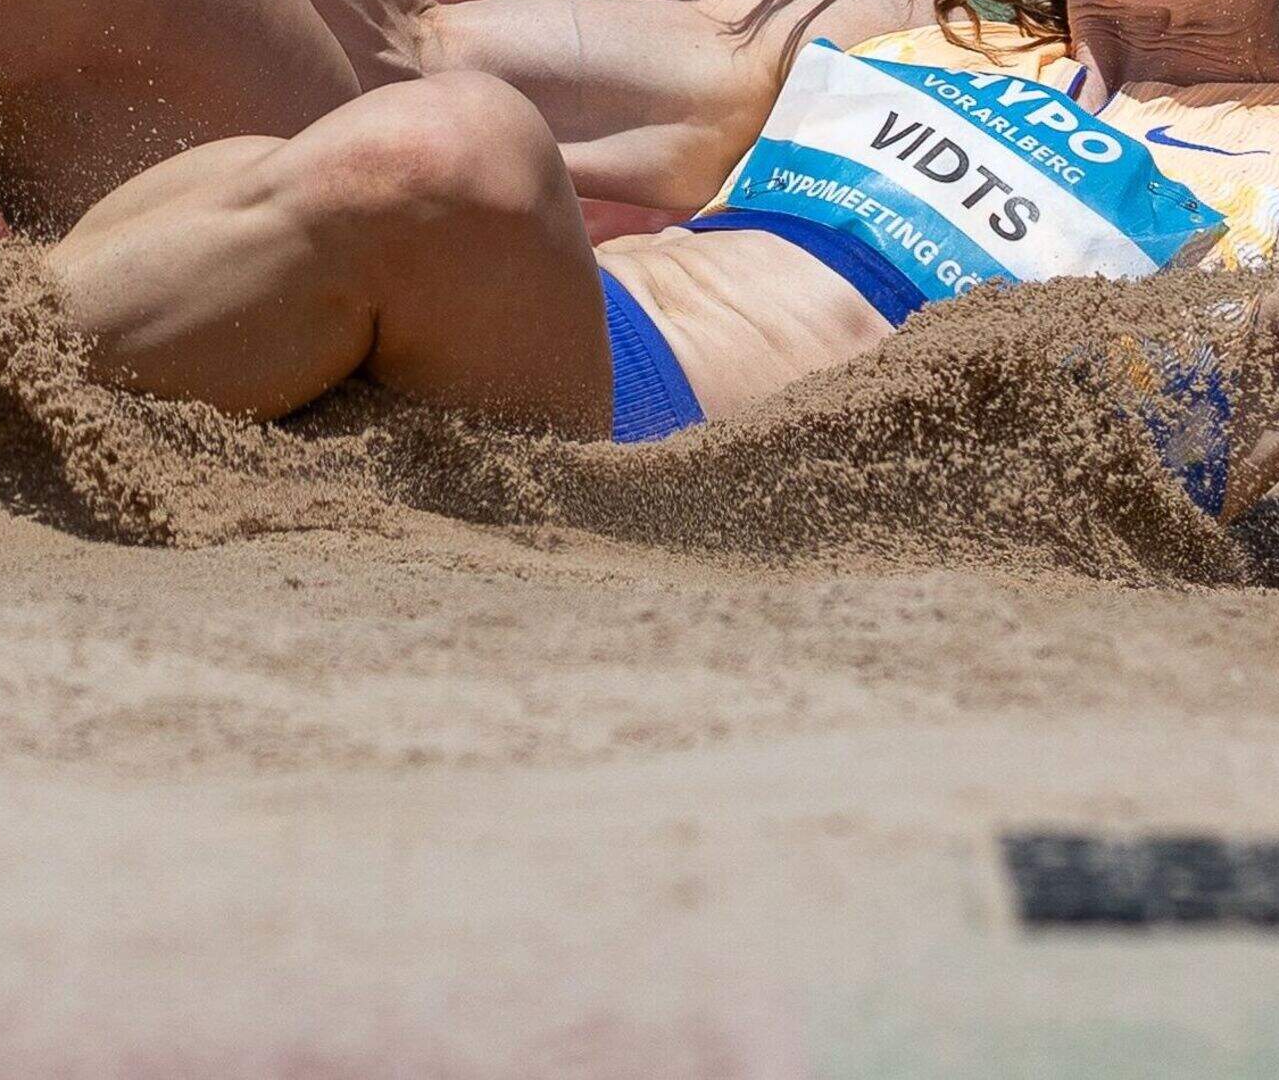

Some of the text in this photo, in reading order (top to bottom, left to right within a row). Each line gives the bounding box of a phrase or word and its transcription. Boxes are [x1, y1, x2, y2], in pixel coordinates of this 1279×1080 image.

[870, 111, 1041, 241] VIDTS
[923, 73, 1086, 185] VORARLBERG
[767, 167, 940, 266] HYPOMEETING
